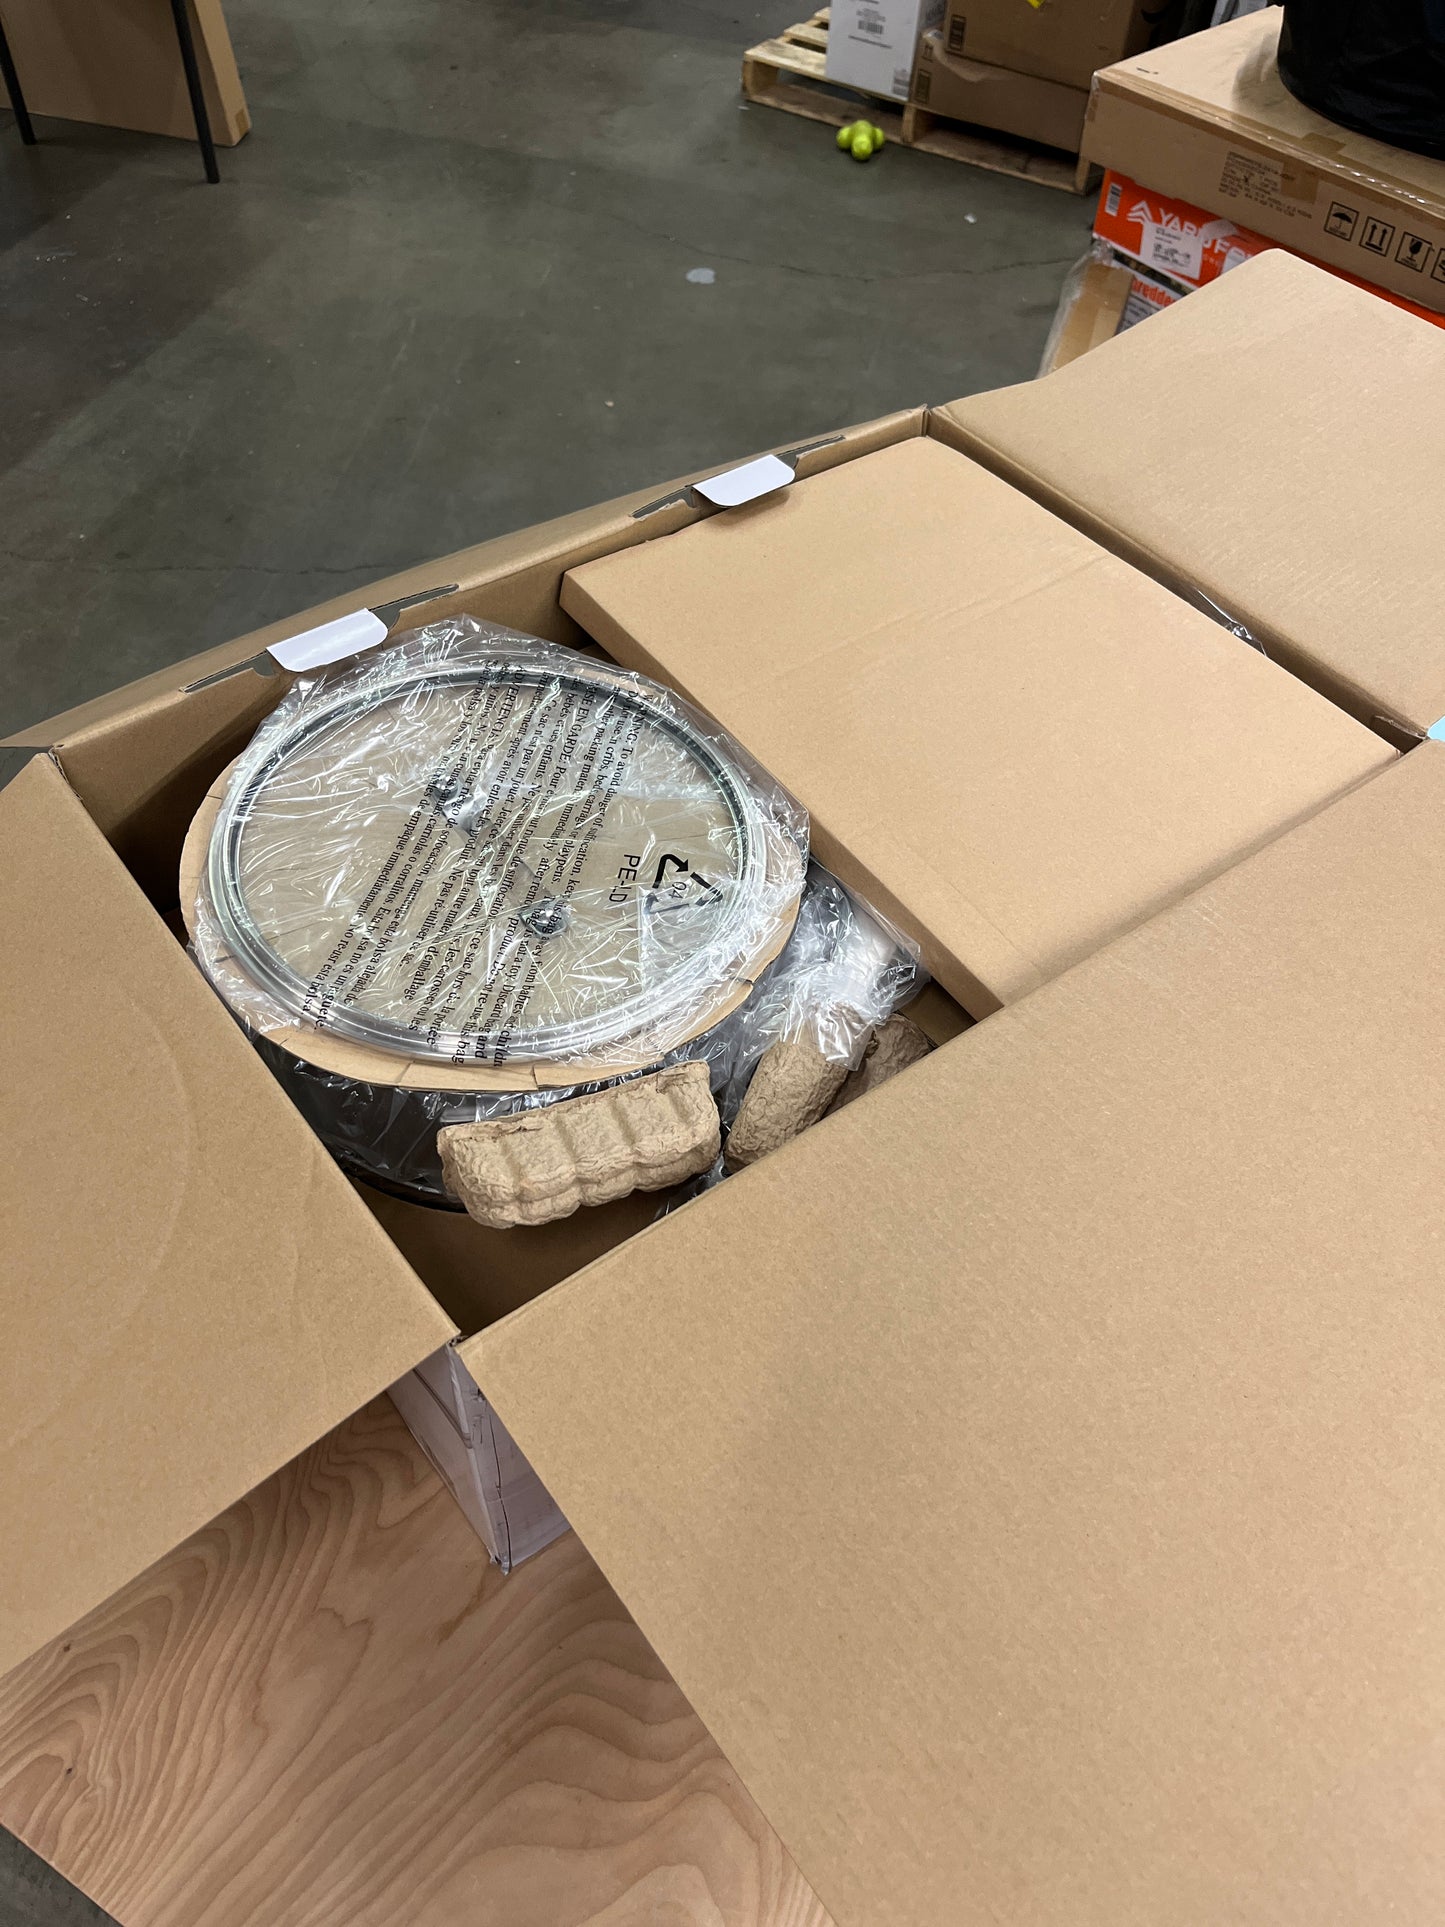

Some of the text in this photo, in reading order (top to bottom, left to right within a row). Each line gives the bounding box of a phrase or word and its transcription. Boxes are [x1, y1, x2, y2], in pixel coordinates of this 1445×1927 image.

[466, 686, 484, 711] bolsa
[478, 693, 497, 721] niños.
[558, 691, 578, 719] bébés
[536, 712, 549, 729] sac
[574, 705, 589, 725] EN
[618, 704, 631, 720] not
[456, 719, 472, 734] los
[471, 721, 487, 737] No
[612, 718, 625, 735] use
[505, 736, 522, 760] après
[528, 728, 544, 749] n'est
[557, 721, 583, 766] GARDE:
[582, 725, 603, 763] packing
[520, 746, 534, 766] pas
[532, 743, 554, 781] enfants.
[597, 745, 615, 773] cribs,
[618, 743, 634, 760] To
[463, 760, 482, 786] evitar
[494, 759, 511, 784] avoir
[514, 766, 527, 780] un
[548, 765, 566, 788] Pour
[608, 760, 625, 788] avoid
[503, 777, 524, 807] jouet.
[526, 781, 542, 797] Ne
[416, 797, 430, 810] de
[450, 785, 471, 817] riesgo
[597, 785, 618, 817] danger
[444, 816, 457, 829] de
[474, 814, 491, 829] les
[492, 805, 512, 828] Jeter
[592, 815, 603, 828] of
[394, 809, 422, 851] empaque
[487, 827, 499, 840] ce
[494, 839, 511, 864] dans
[509, 855, 523, 868] de
[569, 826, 598, 877] suffocation,
[447, 865, 464, 882] Ne
[463, 866, 482, 888] tout
[487, 862, 503, 878] les
[534, 856, 550, 881] after
[382, 862, 413, 906] corralitos.
[438, 879, 453, 898] pas
[392, 877, 424, 920] mantenga
[451, 886, 470, 909] autre
[369, 905, 391, 925] Esta
[415, 897, 444, 941] ré-utiliser
[523, 906, 546, 928] bag
[540, 913, 562, 936] bag
[382, 919, 400, 937] esta
[522, 928, 537, 940] is
[326, 938, 349, 964] re-usr
[368, 936, 392, 965] bolsa
[408, 940, 421, 953] ce
[468, 935, 482, 951] ce
[348, 951, 362, 965] no
[398, 951, 415, 968] sac.
[443, 945, 460, 964] les
[461, 950, 475, 970] sac
[314, 962, 334, 981] ésta
[341, 963, 353, 974] es
[350, 963, 376, 994] alejada
[403, 944, 439, 1001] d'emballage
[451, 968, 471, 990] hors
[504, 962, 521, 983] toy.
[524, 958, 543, 985] from
[332, 973, 348, 987] un
[299, 979, 324, 1016] bolsa.
[444, 990, 460, 1005] de
[468, 991, 488, 1021] re-use
[489, 981, 516, 1020] Discard
[511, 982, 534, 1016] babies
[415, 1005, 429, 1017] ou
[440, 1003, 456, 1014] la
[409, 1015, 425, 1032] les
[459, 1020, 477, 1038] this
[477, 1017, 498, 1035] bag
[474, 1033, 487, 1061] and
